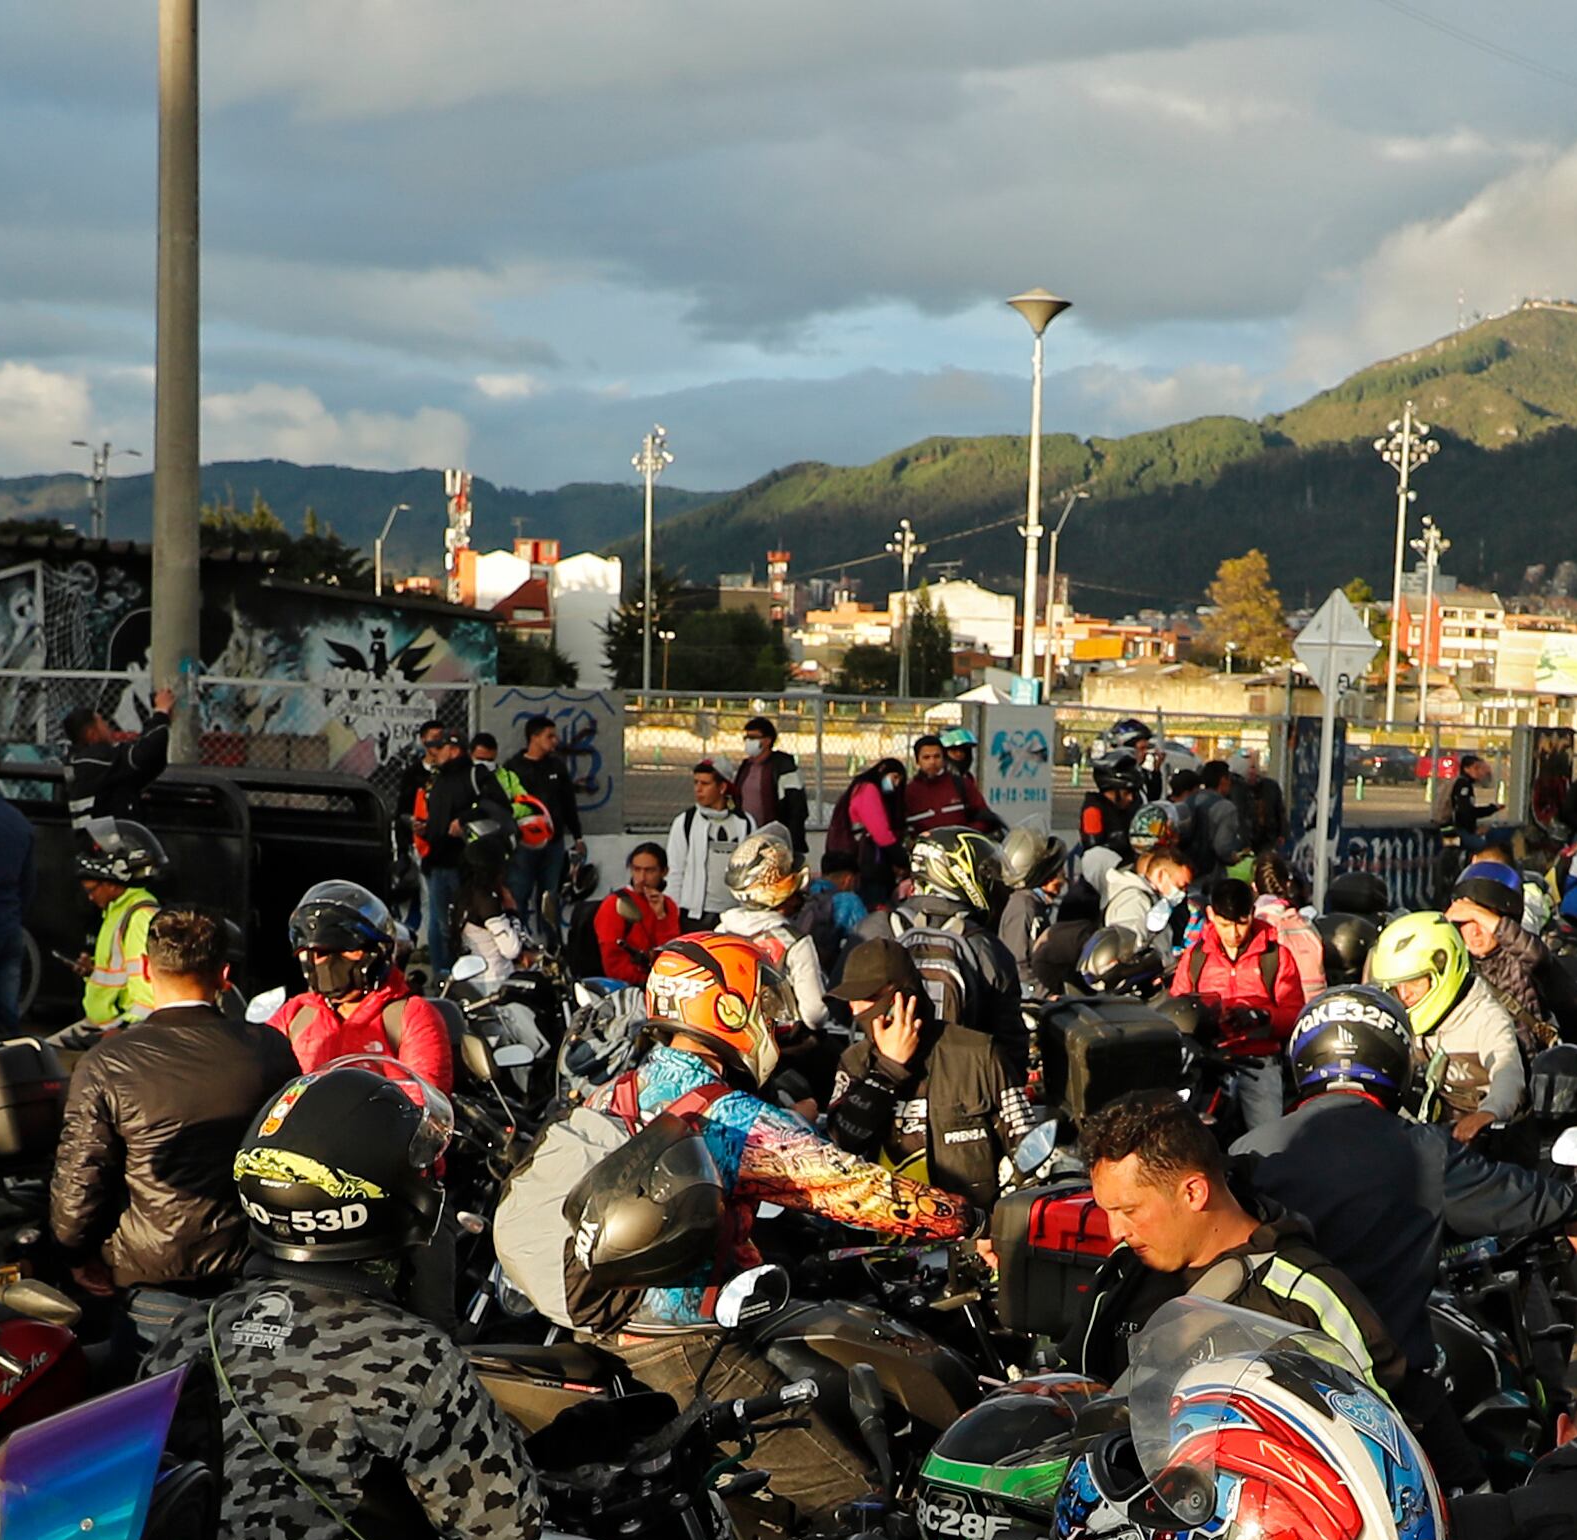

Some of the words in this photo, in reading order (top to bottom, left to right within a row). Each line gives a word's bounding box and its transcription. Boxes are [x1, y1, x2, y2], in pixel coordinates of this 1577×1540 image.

[943, 1127, 988, 1144] PRENSA
[230, 1320, 293, 1338] CASCOS
[232, 1331, 286, 1350] STORE
